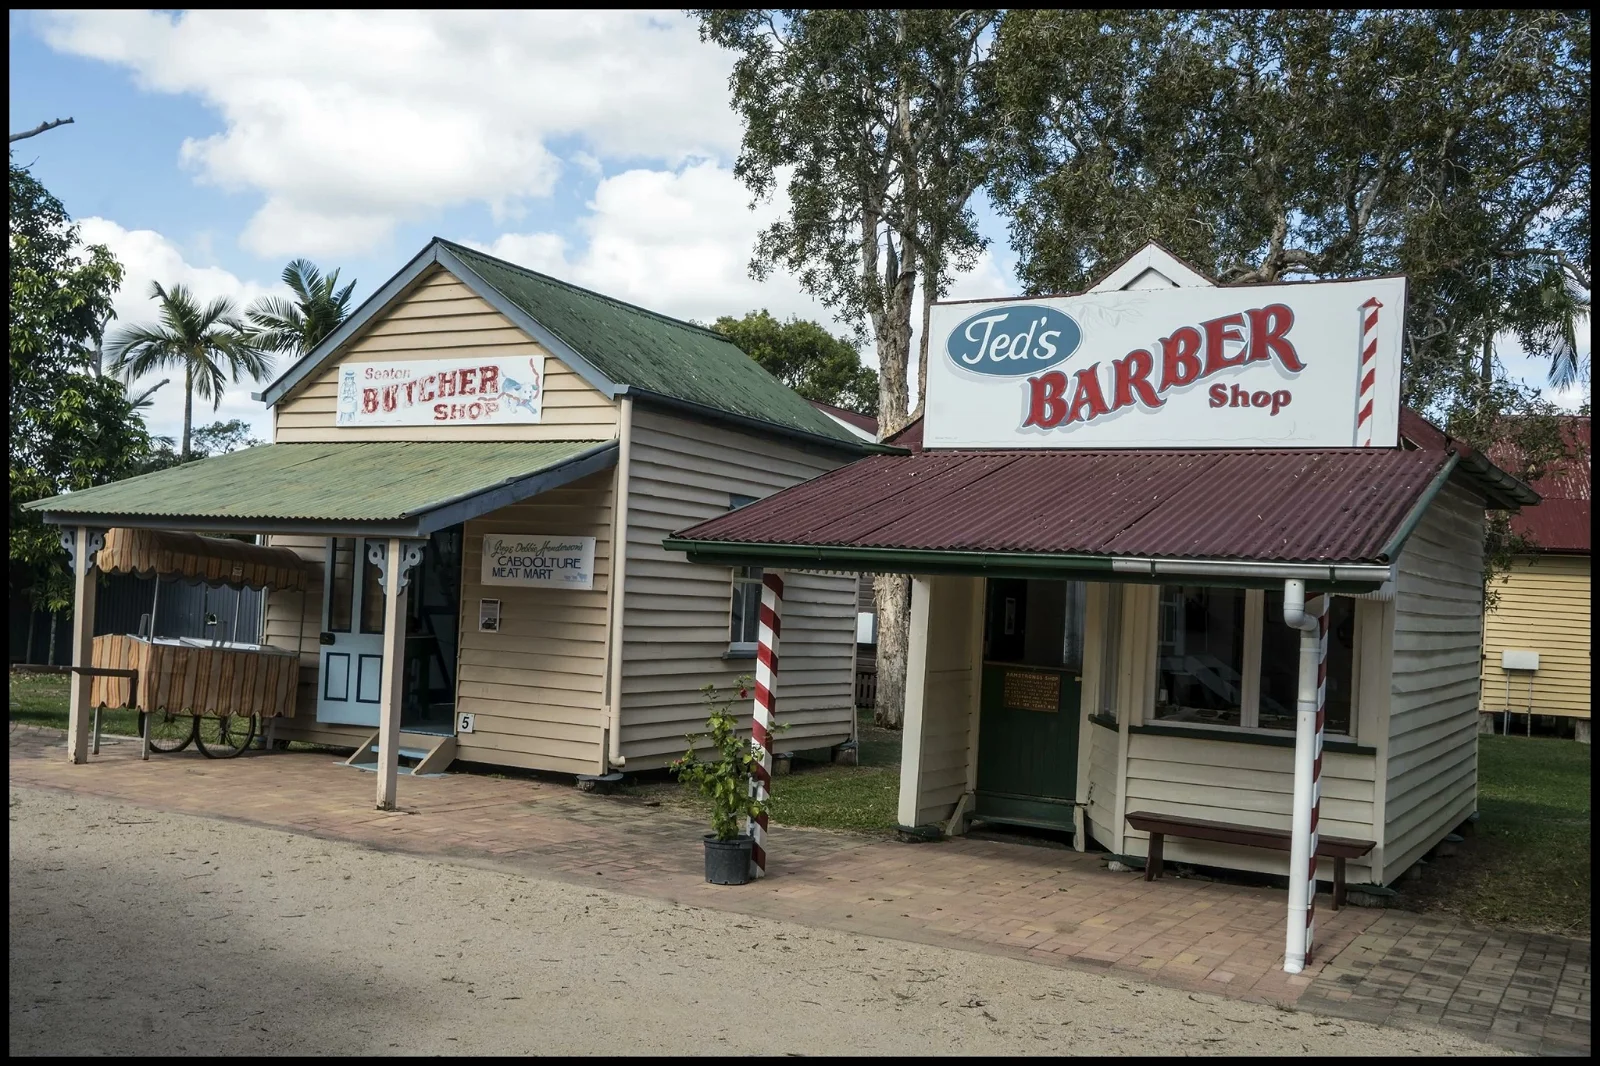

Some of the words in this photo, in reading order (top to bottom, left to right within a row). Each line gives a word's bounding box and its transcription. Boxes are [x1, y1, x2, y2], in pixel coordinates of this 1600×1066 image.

[961, 312, 1062, 365] Ted's
[1022, 303, 1307, 429] BARBER
[360, 365, 499, 415] BUTCHER
[1208, 383, 1292, 416] Shop
[433, 402, 500, 421] SHOP
[515, 542, 537, 553] Debbie
[497, 555, 581, 569] CABOOLTURE
[492, 567, 521, 578] MEAT
[523, 568, 554, 580] MART
[462, 716, 470, 730] 5
